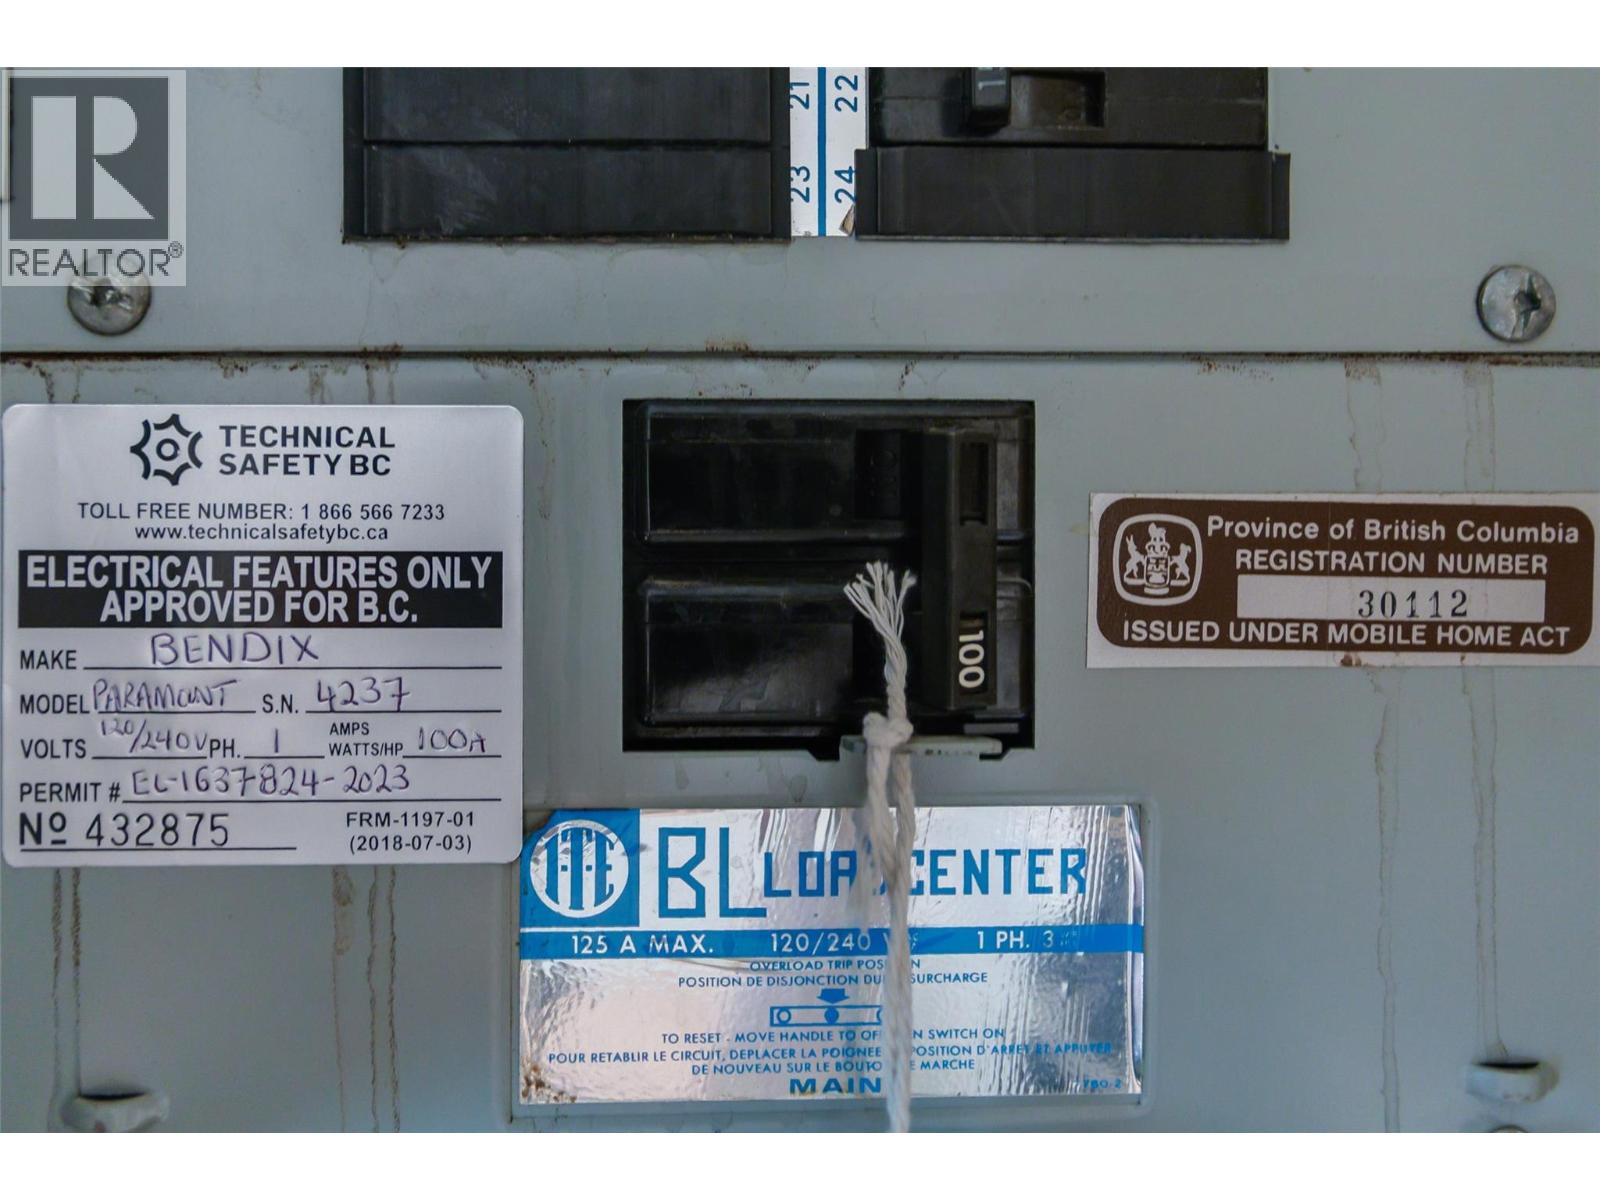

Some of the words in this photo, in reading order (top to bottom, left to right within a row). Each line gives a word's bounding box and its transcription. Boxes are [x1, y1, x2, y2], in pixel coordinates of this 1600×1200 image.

[790, 82, 809, 109] 21
[835, 75, 858, 113] 22
[791, 166, 810, 203] 23
[835, 166, 856, 203] 24
[219, 425, 395, 449] TECHNICAL
[219, 453, 341, 477] SAFETY
[350, 453, 391, 476] BC
[78, 502, 130, 520] TOLL
[136, 503, 191, 520] FREE
[198, 503, 294, 521] NUMBER:
[301, 504, 309, 520] 1
[318, 504, 353, 521] 866
[360, 504, 393, 521] 566
[401, 504, 445, 521] 7233
[135, 523, 388, 543] www.technicalsafetybc.ca
[1208, 515, 1319, 539] Province
[1329, 518, 1354, 539] of
[1364, 518, 1446, 541] British
[1456, 520, 1579, 543] Columbia
[26, 554, 224, 589] ELECTRICAL
[233, 555, 398, 589] FEATURES
[407, 555, 492, 589] ONLY
[1235, 549, 1425, 573] REGISTRATION
[1438, 553, 1547, 575] NUMBER
[100, 589, 275, 623] APPROVED
[284, 590, 349, 623] FOR
[358, 590, 418, 623] B.C.
[1358, 589, 1468, 618] 30112
[1123, 620, 1220, 642] ISSUED
[1229, 621, 1318, 643] UNDER
[1328, 623, 1426, 645] MOBILE
[1437, 625, 1511, 646] HOME
[1520, 626, 1570, 647] ACT
[20, 649, 77, 670] MAKE
[151, 632, 319, 666] BENDIX
[959, 630, 984, 688] 100
[20, 694, 90, 714] MODEL
[262, 694, 299, 713] S.N.
[317, 676, 411, 712] 4237
[329, 722, 370, 736] AMPS
[20, 738, 87, 759] VOLTS
[209, 738, 241, 758] PH.
[328, 742, 403, 757] WATTS/HP
[418, 727, 487, 753] 100A
[19, 782, 102, 803] PERMIT
[109, 782, 121, 801] #
[86, 812, 229, 847] 432875
[346, 811, 474, 828] FRM-1197-01
[350, 835, 472, 855] (2018-07-03)
[657, 827, 768, 919] BL
[572, 934, 608, 954] 125
[619, 935, 636, 954] A
[650, 933, 714, 954] MAX.
[771, 931, 871, 955] 120/240
[976, 930, 984, 949] 1
[995, 929, 1030, 949] PH.
[750, 958, 823, 972] OVERLOAD
[828, 959, 852, 971] TRIP
[679, 975, 742, 988] POSITION
[746, 975, 763, 987] DE
[767, 973, 859, 987] DISJONCTION
[662, 1033, 679, 1044] TO
[684, 1032, 721, 1044] RESET
[735, 1031, 775, 1043] MOVE
[780, 1031, 833, 1042] HANDLE
[839, 1030, 857, 1042] TO
[928, 1028, 978, 1041] SWITCH
[983, 1028, 1005, 1040] ON
[549, 1053, 585, 1064] POUR
[591, 1051, 648, 1063] RETABLIR
[654, 1051, 666, 1062] LE
[730, 1048, 796, 1060] DEPLACER
[801, 1048, 817, 1059] LA
[692, 1064, 708, 1076] DE
[713, 1063, 781, 1075] NOUVEAU
[787, 1062, 811, 1074] SUR
[816, 1062, 830, 1073] LE
[921, 1059, 975, 1071] MARCHE
[789, 1077, 882, 1095] MAIN
